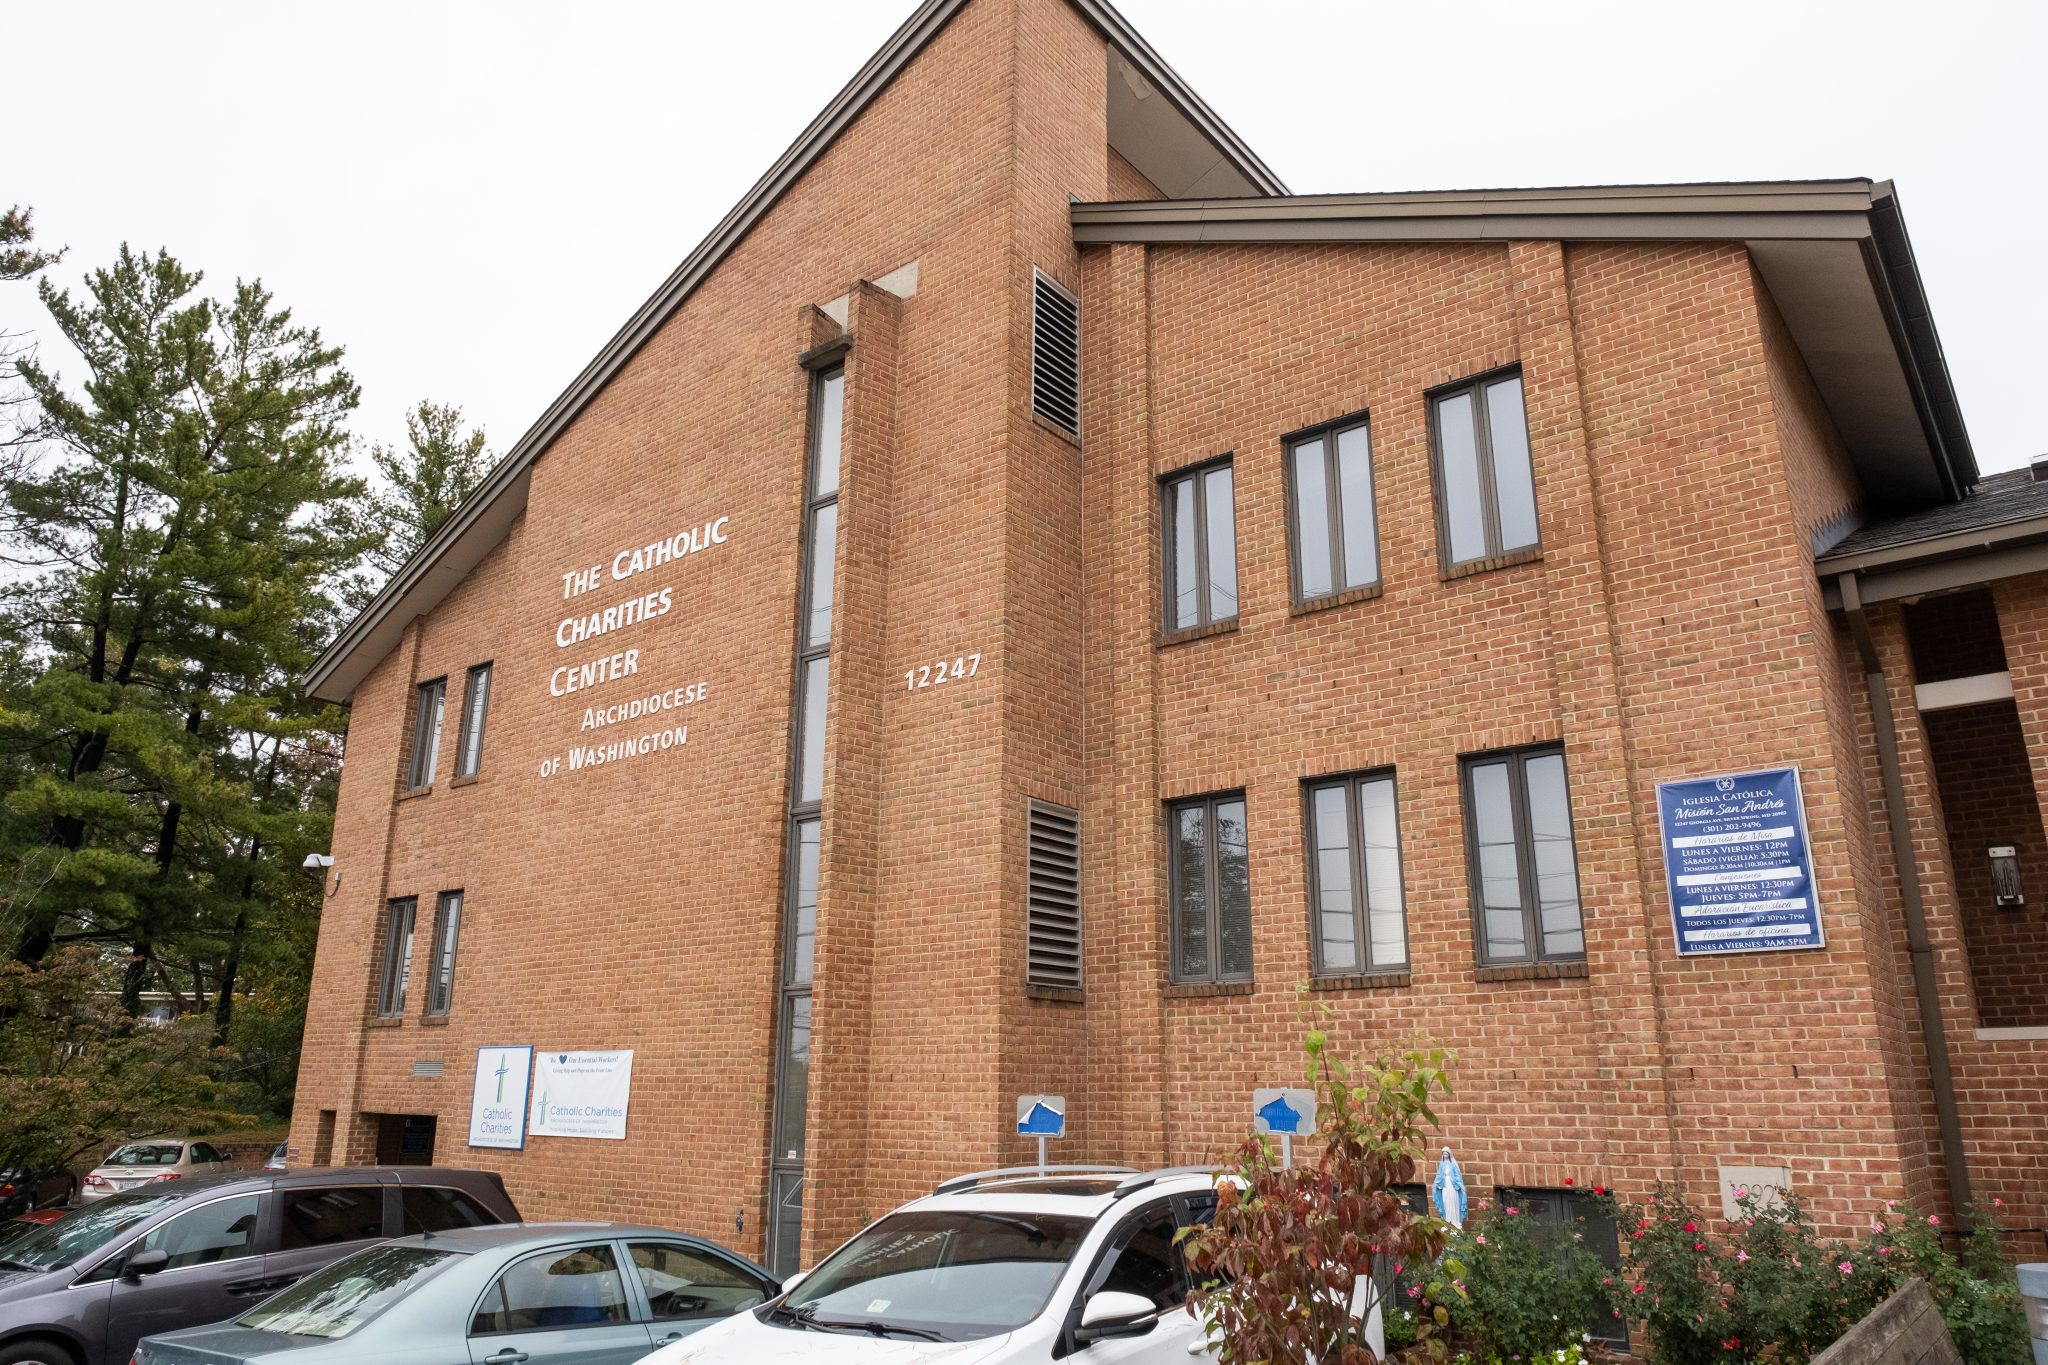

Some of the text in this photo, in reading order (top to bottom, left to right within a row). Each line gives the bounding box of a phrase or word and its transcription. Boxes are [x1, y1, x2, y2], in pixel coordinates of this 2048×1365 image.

[562, 516, 729, 600] THE CATHOLIC
[556, 587, 673, 648] CHARITIES
[550, 649, 639, 697] CENTER
[904, 652, 981, 691] 12247
[581, 682, 708, 732] ARCHDIOCESE
[569, 725, 688, 771] WASHINGTON
[1683, 789, 1773, 806] IGLESIA CATÓLICA
[1675, 798, 1786, 820] Misión San Andrés
[1703, 821, 1762, 833] (301) 202-9496
[1737, 832, 1747, 841] de
[1750, 831, 1773, 840] Misa
[1682, 849, 1711, 857] LUNES
[1720, 845, 1762, 853] VIERNES:
[1765, 841, 1788, 850] 12PM
[1760, 850, 1789, 859] 5:30PM
[1686, 886, 1712, 894] LUNES
[1721, 883, 1758, 892] VIERNES:
[1761, 880, 1794, 889] 12:30PM
[1701, 893, 1736, 903] JUEVES:
[1728, 917, 1755, 925] JUEVES:
[1745, 927, 1756, 935] de
[1759, 927, 1790, 937] oficina
[1690, 943, 1717, 951] LUNES
[1725, 940, 1763, 949] VIERNES:
[482, 1107, 513, 1120] Catholic
[550, 1105, 623, 1117] Catholic Charities
[480, 1121, 513, 1134] Charities
[1731, 1183, 1779, 1204] 992
